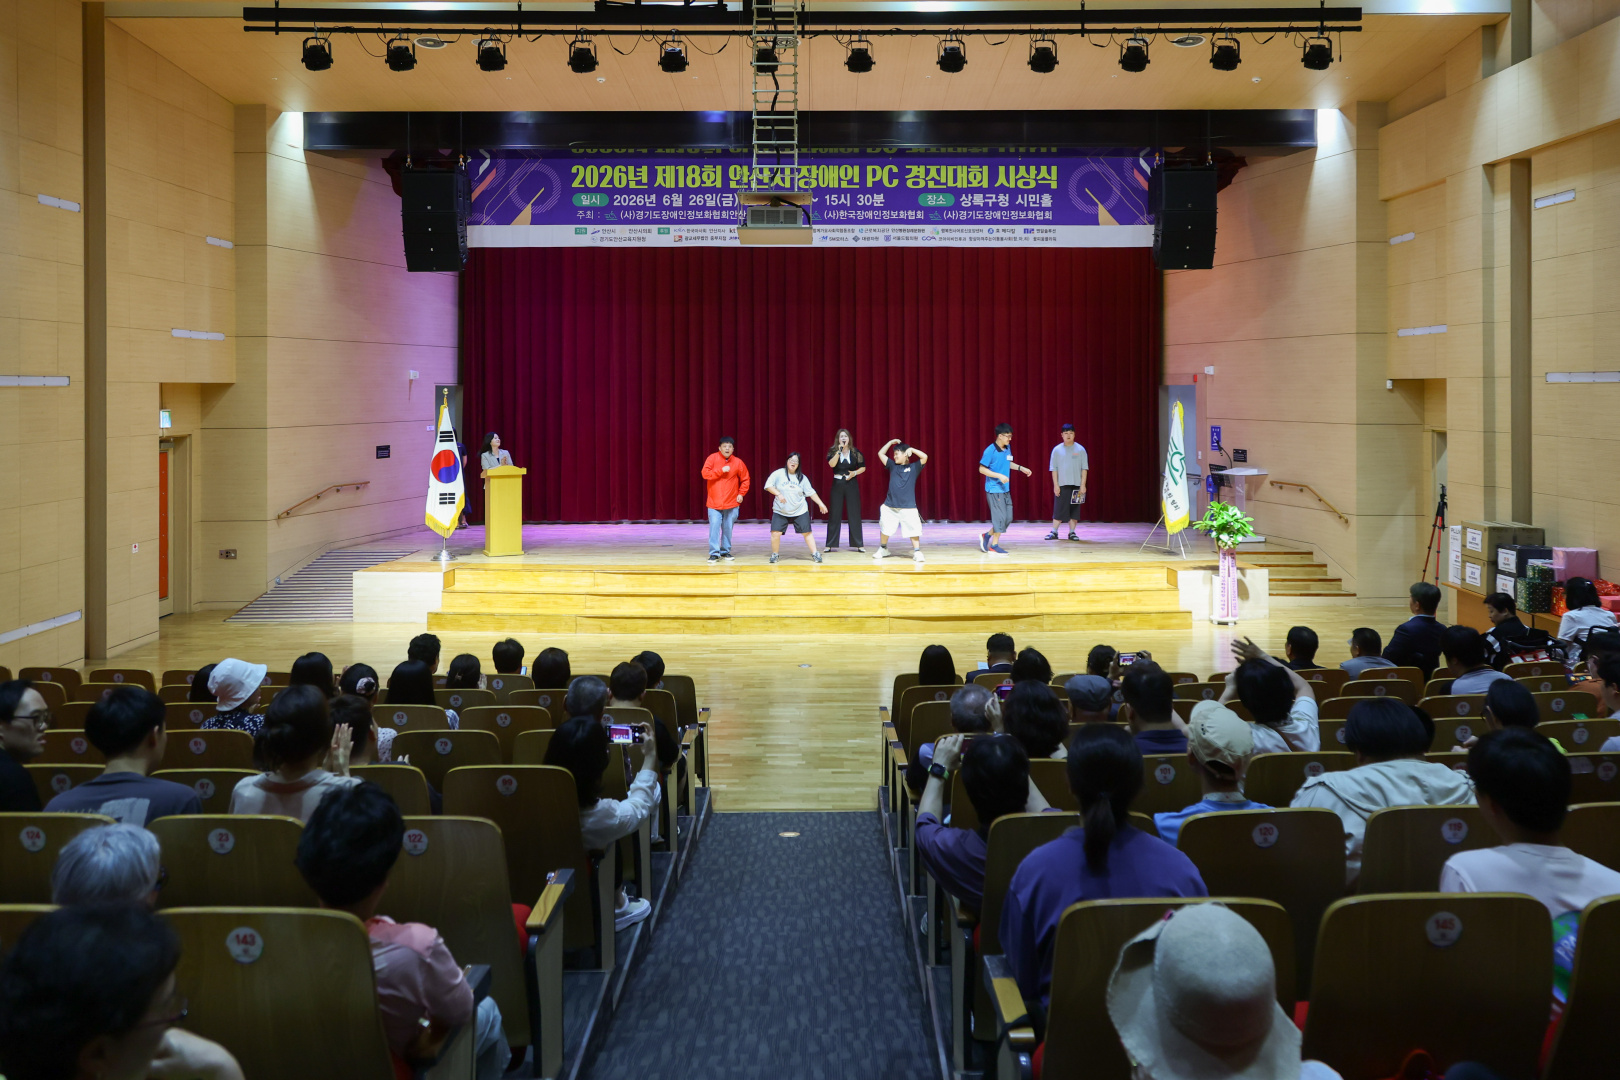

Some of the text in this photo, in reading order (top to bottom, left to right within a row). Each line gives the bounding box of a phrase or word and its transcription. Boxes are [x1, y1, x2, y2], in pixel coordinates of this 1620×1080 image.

[571, 165, 648, 188] 2026년
[654, 165, 722, 188] 제18회
[797, 165, 860, 188] 장애인
[867, 165, 899, 188] PC
[905, 165, 988, 188] 경진대회
[994, 165, 1057, 189] 시상식
[581, 194, 600, 205] 일시
[613, 194, 656, 206] 2026년
[663, 194, 683, 206] 6월
[689, 193, 738, 206] 26일(금)
[824, 194, 850, 206] 15시
[856, 194, 885, 206] 30분
[926, 194, 1053, 207] 장소 상록구청 시민홀
[576, 210, 594, 219] 주최
[620, 210, 747, 220] (사)경기도장애인정보화협회안산
[824, 210, 1053, 220] (사)한국장애인정보화협회 (사)경기도장애인정보화협회
[26, 831, 41, 840] 124
[1259, 827, 1274, 836] 120
[235, 934, 256, 946] 143
